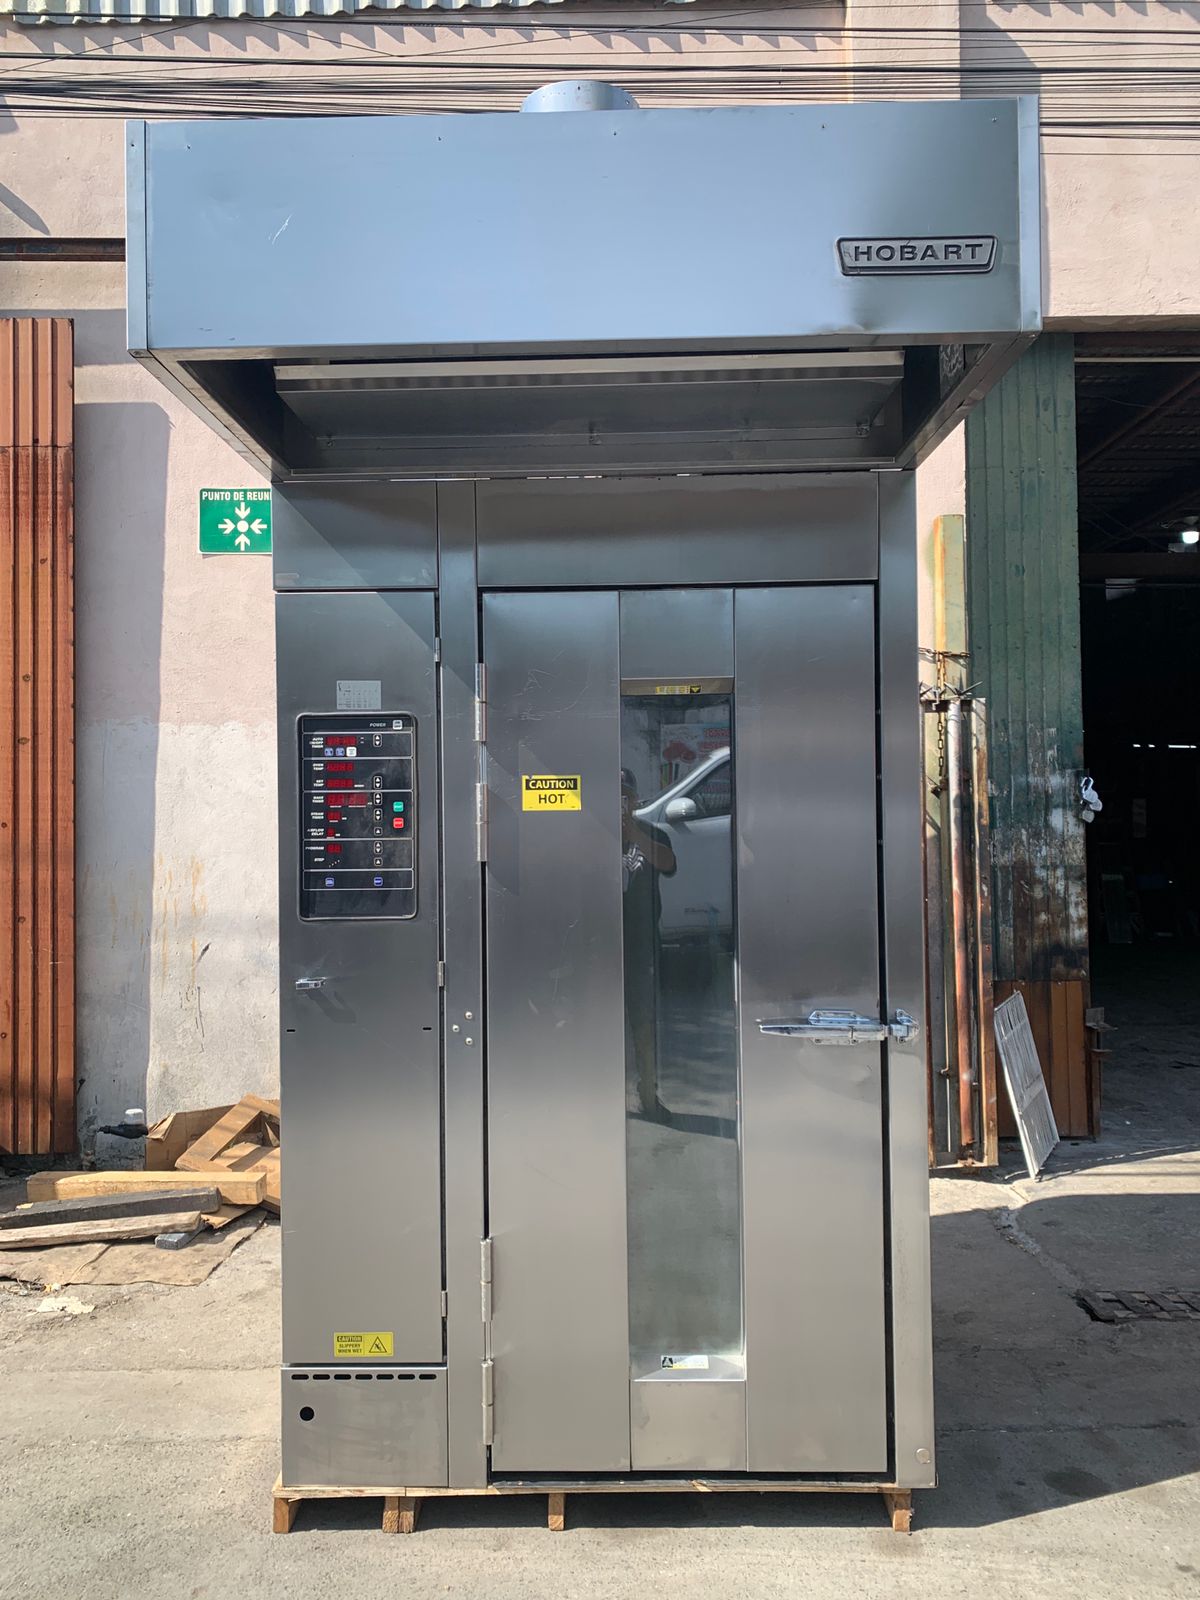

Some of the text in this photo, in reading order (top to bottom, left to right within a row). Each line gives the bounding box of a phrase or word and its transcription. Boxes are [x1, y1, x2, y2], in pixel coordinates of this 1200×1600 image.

[854, 243, 984, 262] HOBART
[202, 491, 231, 501] PUNTO
[233, 491, 245, 501] DE
[528, 780, 574, 789] CAUTION
[538, 793, 566, 804] HOT
